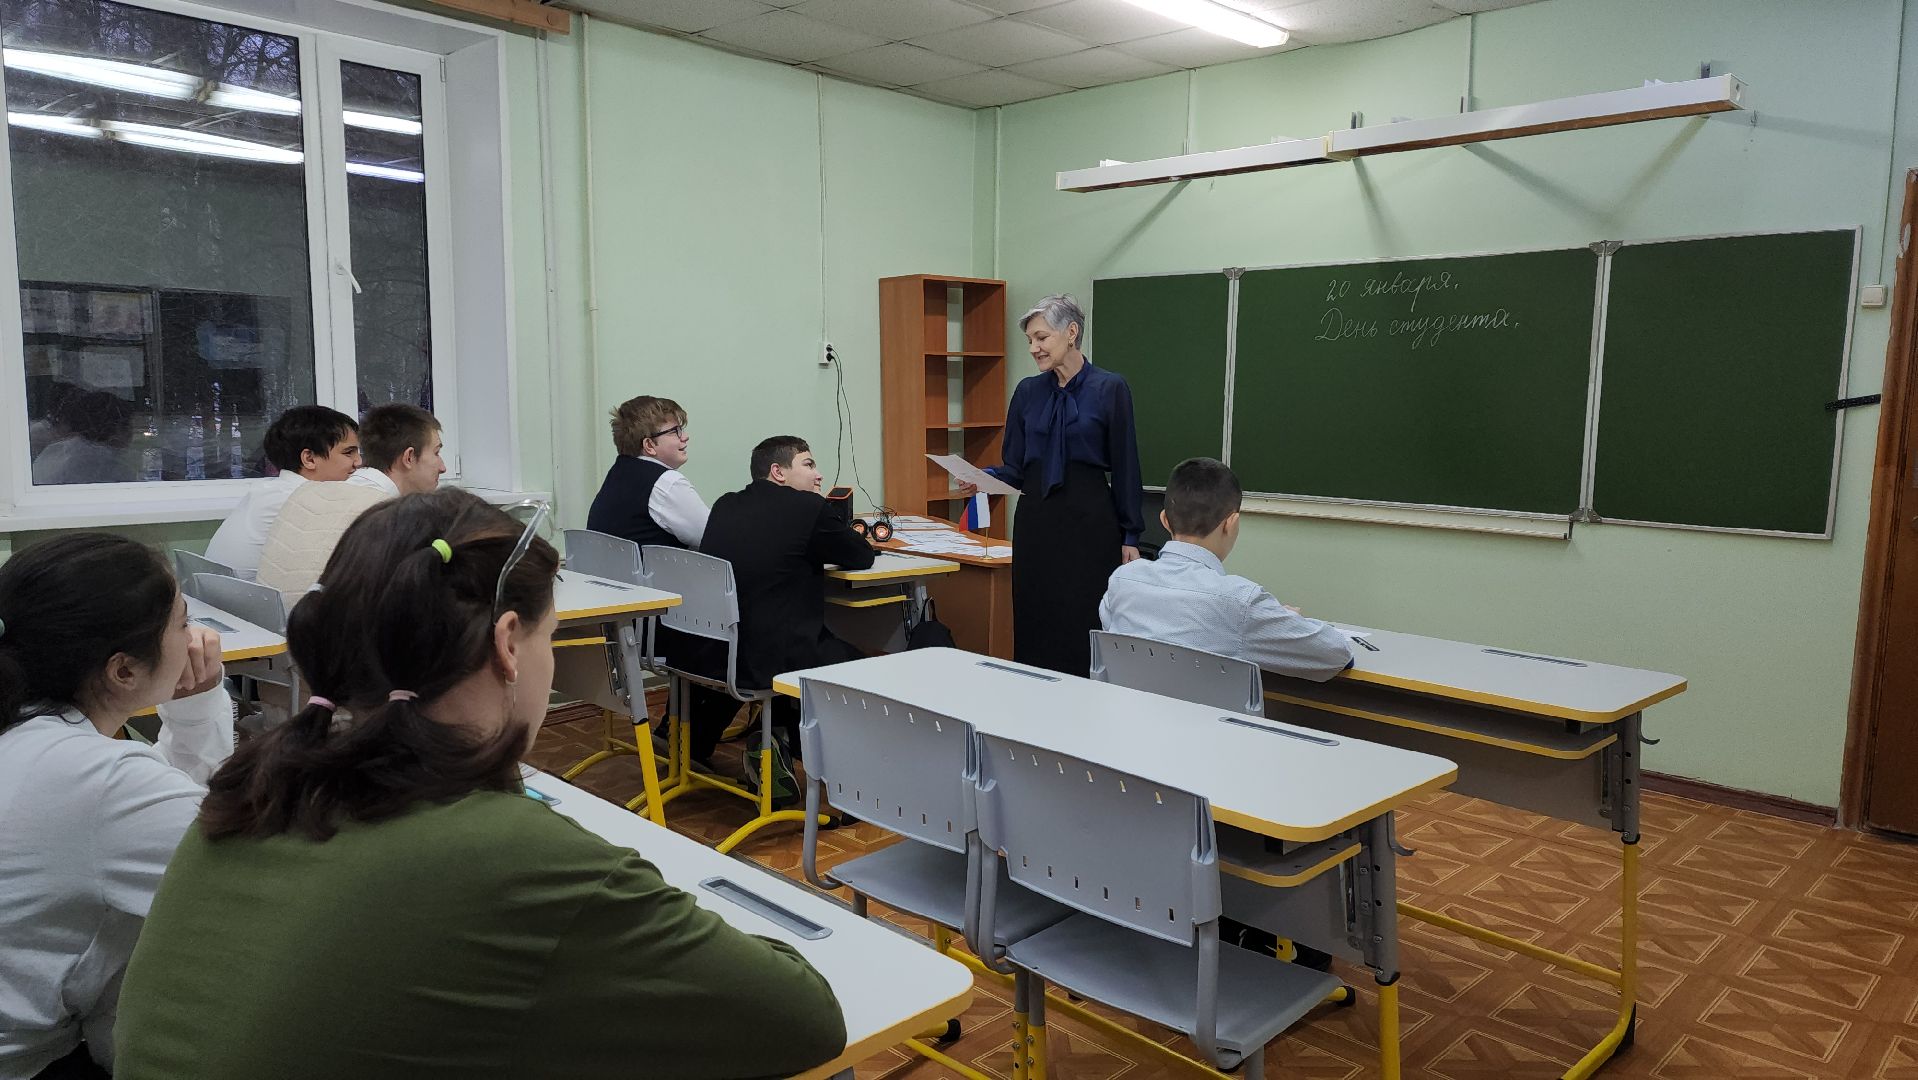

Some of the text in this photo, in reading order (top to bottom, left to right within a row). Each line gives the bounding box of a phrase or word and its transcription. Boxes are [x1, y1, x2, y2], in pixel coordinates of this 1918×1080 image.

[1326, 271, 1459, 312] 20 января.
[1314, 307, 1520, 350] День студента.
